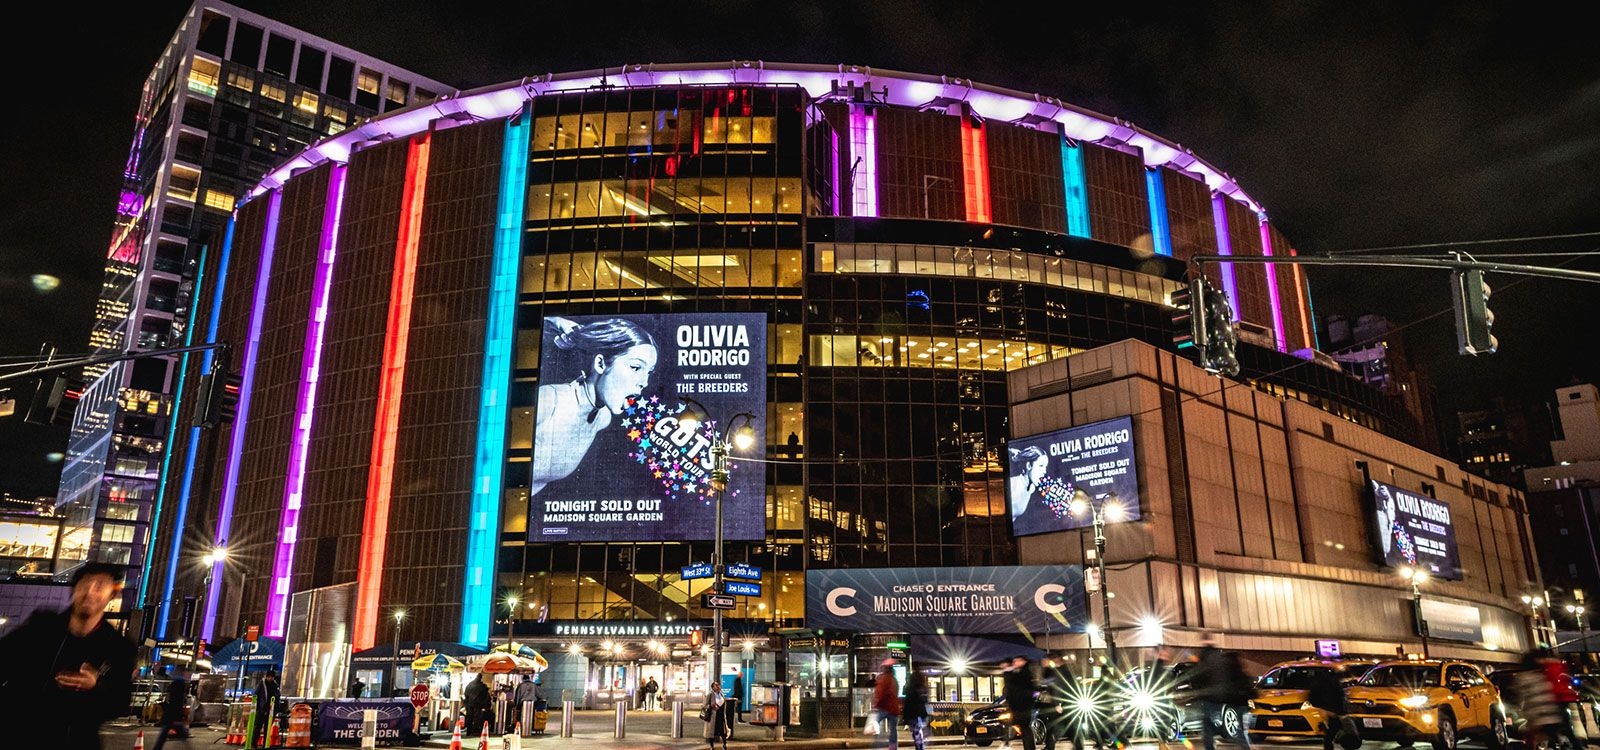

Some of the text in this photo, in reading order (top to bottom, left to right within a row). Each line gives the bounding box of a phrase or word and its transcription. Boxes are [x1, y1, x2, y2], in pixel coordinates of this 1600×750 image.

[676, 325, 750, 348] OLIVIA
[677, 350, 750, 366] RODRIGO
[676, 382, 748, 393] THE BREEDERS
[649, 430, 680, 458] WORLD
[1050, 429, 1129, 456] OLIVIA RODRIGO
[1092, 446, 1118, 457] BREEDERS
[679, 458, 705, 478] TOUR
[1071, 465, 1098, 475] TONIGHT
[1099, 461, 1115, 470] SOLD
[1076, 468, 1127, 481] MADISON SQUARE
[1089, 478, 1113, 487] GARDEN
[544, 499, 662, 512] TONIGHT SOLD OUT
[1396, 492, 1421, 516] OLIVIA
[1420, 499, 1450, 525] RODRIGO
[544, 512, 663, 522] MADISON SQUARE GARDEN
[684, 568, 695, 576] West
[705, 566, 711, 575] St
[729, 566, 758, 577] Eighth Ave
[738, 584, 750, 593] Louis
[893, 584, 995, 593] CHASE ENTRANCE
[826, 587, 857, 616] C
[874, 594, 1013, 612] MADISON SQUARE GARDEN
[1034, 584, 1067, 613] C
[556, 626, 700, 635] PENNSYLVANIA STATIO
[412, 691, 429, 701] STOP
[333, 729, 399, 738] THE GRDEN
